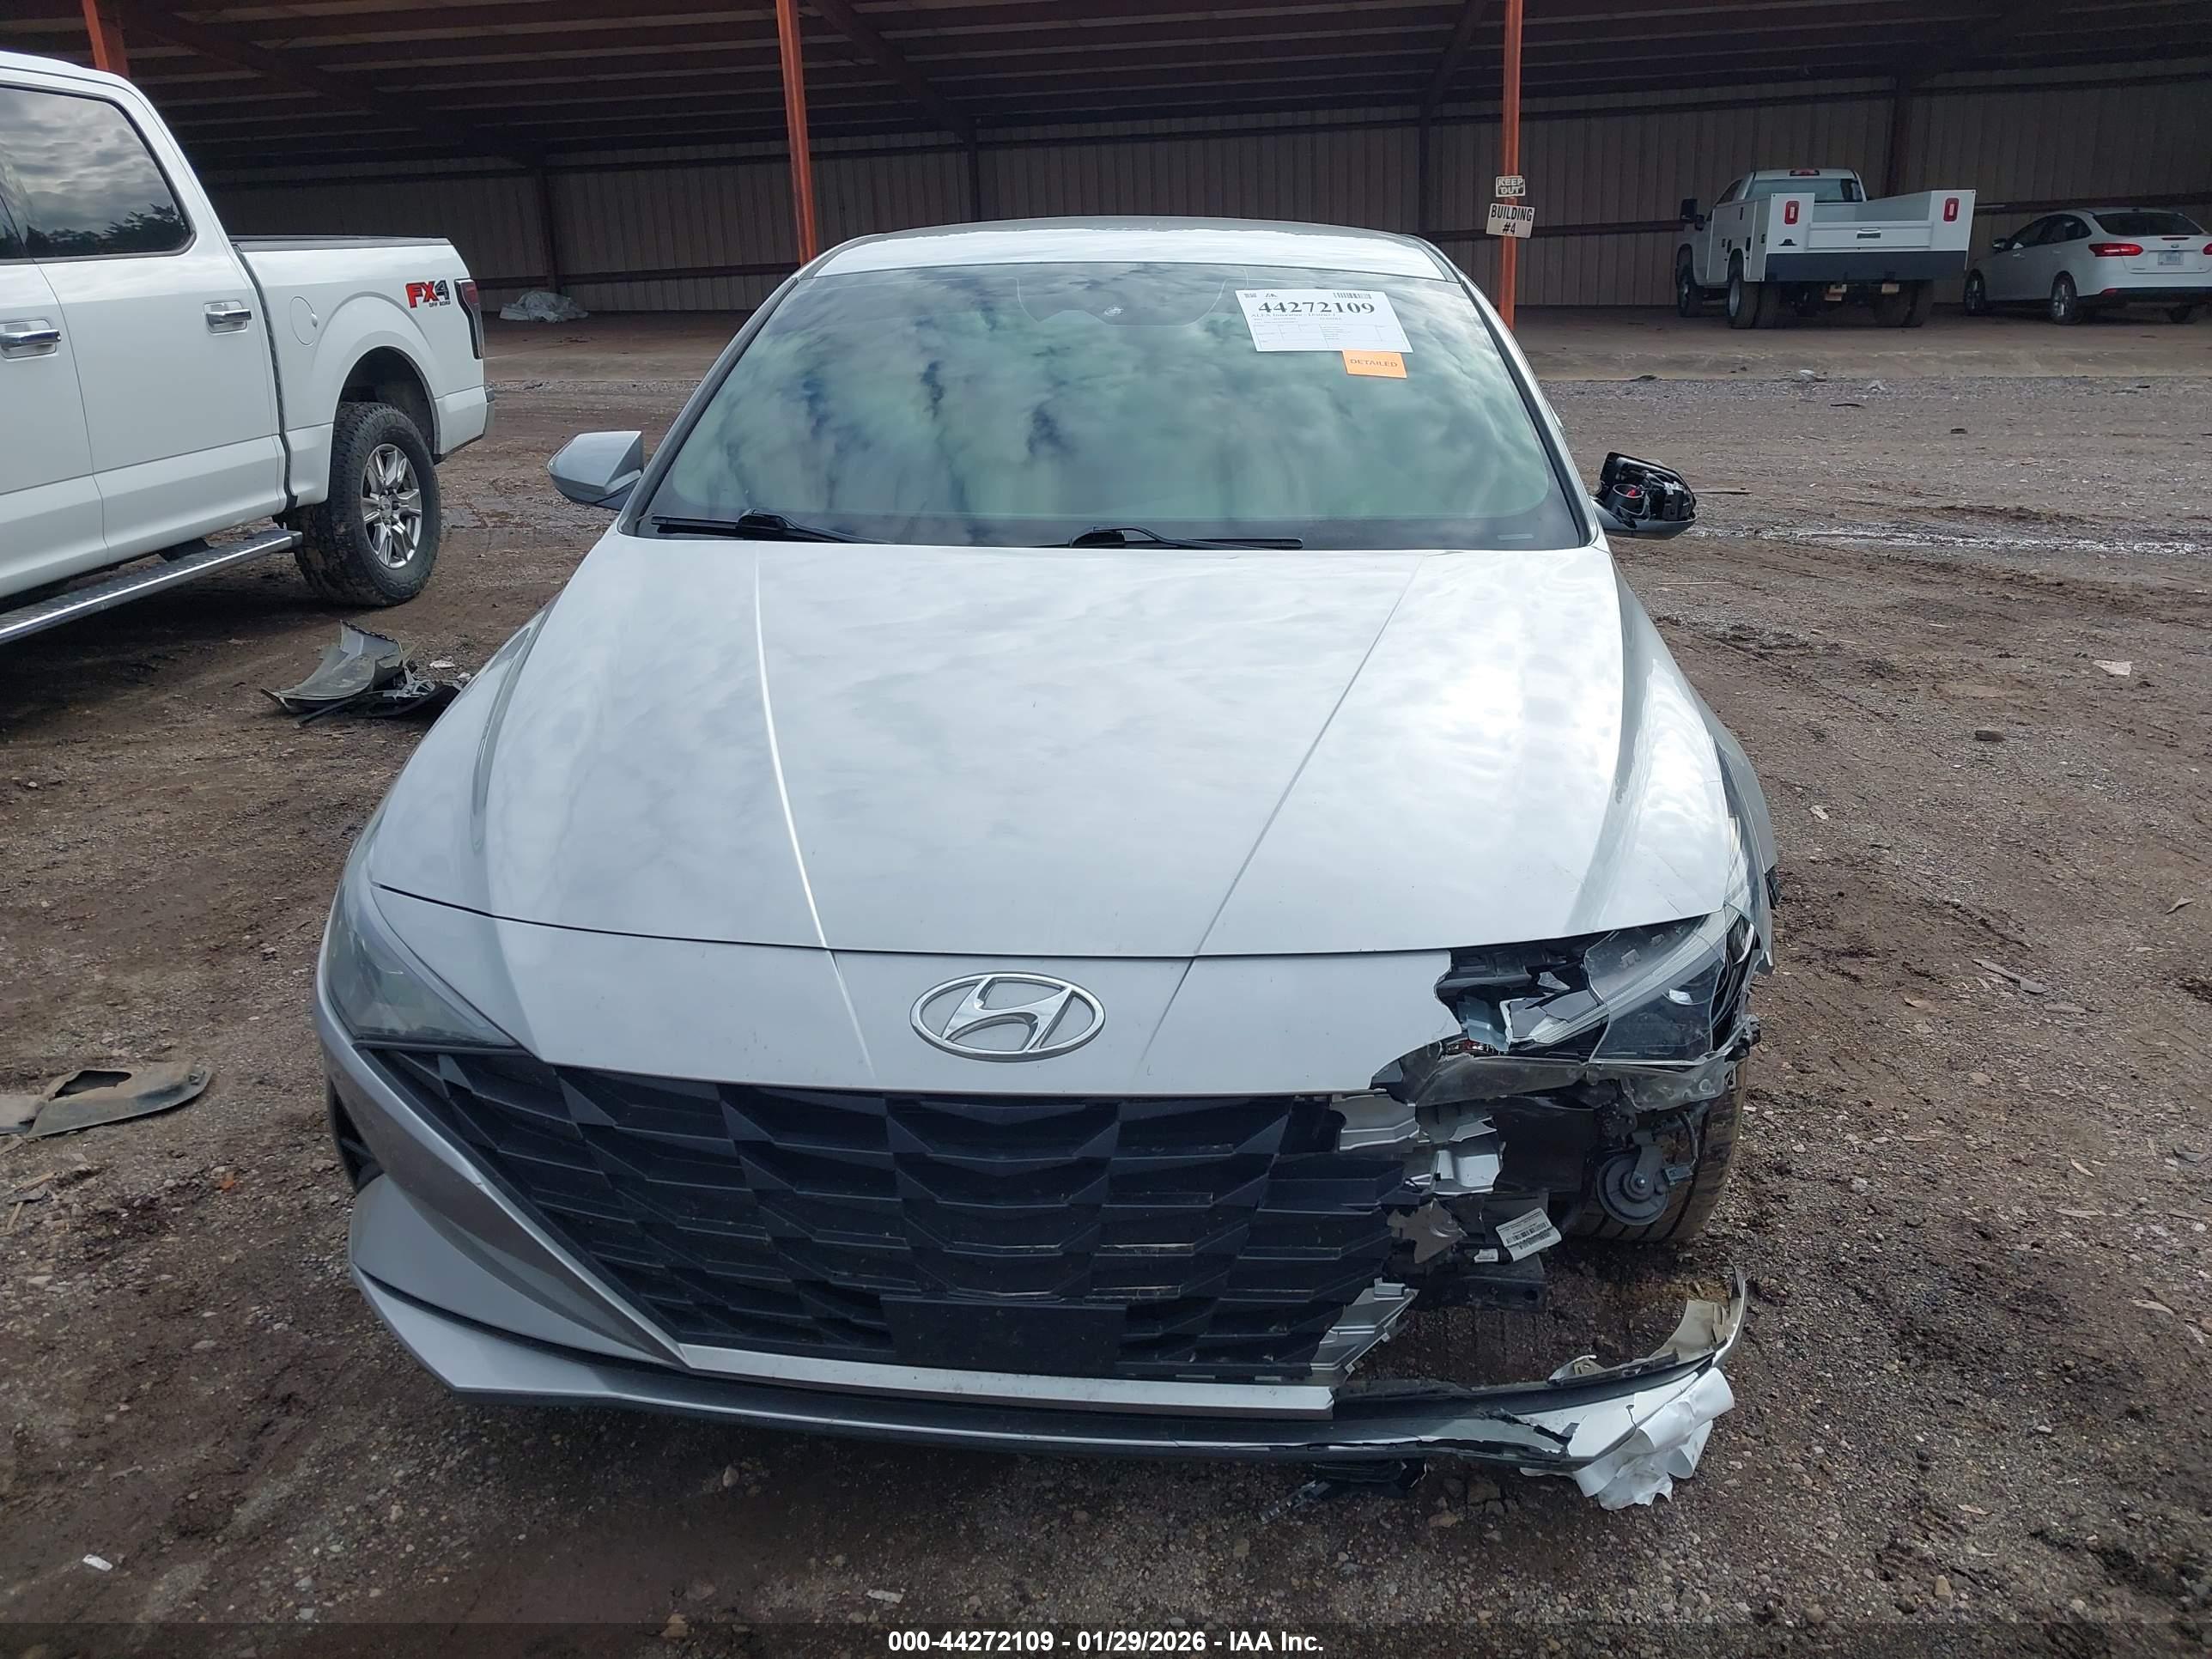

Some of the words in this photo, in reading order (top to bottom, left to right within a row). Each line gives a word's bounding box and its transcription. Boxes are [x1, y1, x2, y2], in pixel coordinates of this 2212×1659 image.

[1498, 178, 1523, 186] KEEP
[1491, 204, 1533, 222] BUILDING
[1503, 222, 1516, 234] #4
[405, 280, 450, 308] FX4
[1257, 301, 1376, 313] 44272109
[1349, 358, 1398, 368] DETAILED
